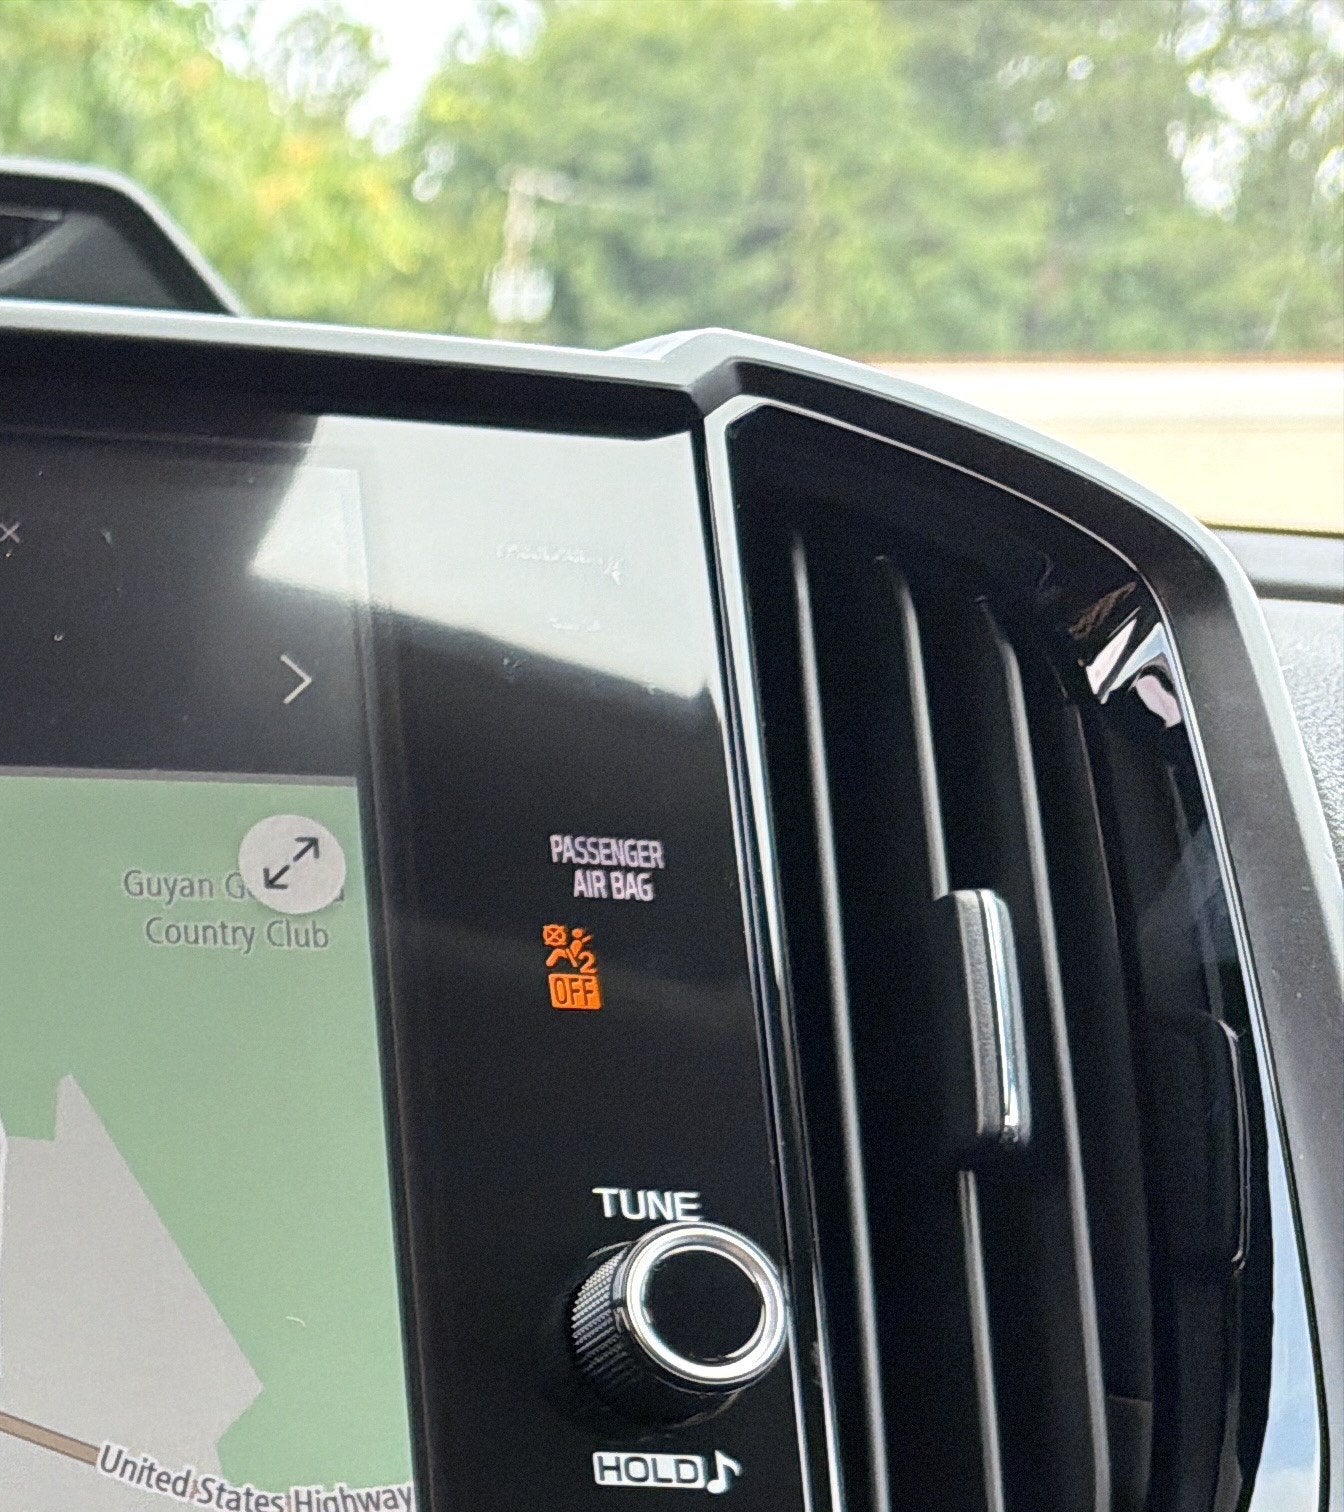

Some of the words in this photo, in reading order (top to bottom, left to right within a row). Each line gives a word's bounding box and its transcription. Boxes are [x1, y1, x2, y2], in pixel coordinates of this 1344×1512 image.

[549, 834, 666, 869] PASSENGER
[123, 869, 214, 905] Guyan
[573, 869, 608, 899] AIR
[610, 871, 655, 902] BAG
[145, 917, 256, 953] Country
[266, 919, 330, 949] Club
[552, 977, 595, 1005] OFF
[592, 1187, 702, 1222] TUNE
[99, 1444, 192, 1498] United
[596, 1455, 700, 1485] HOLD
